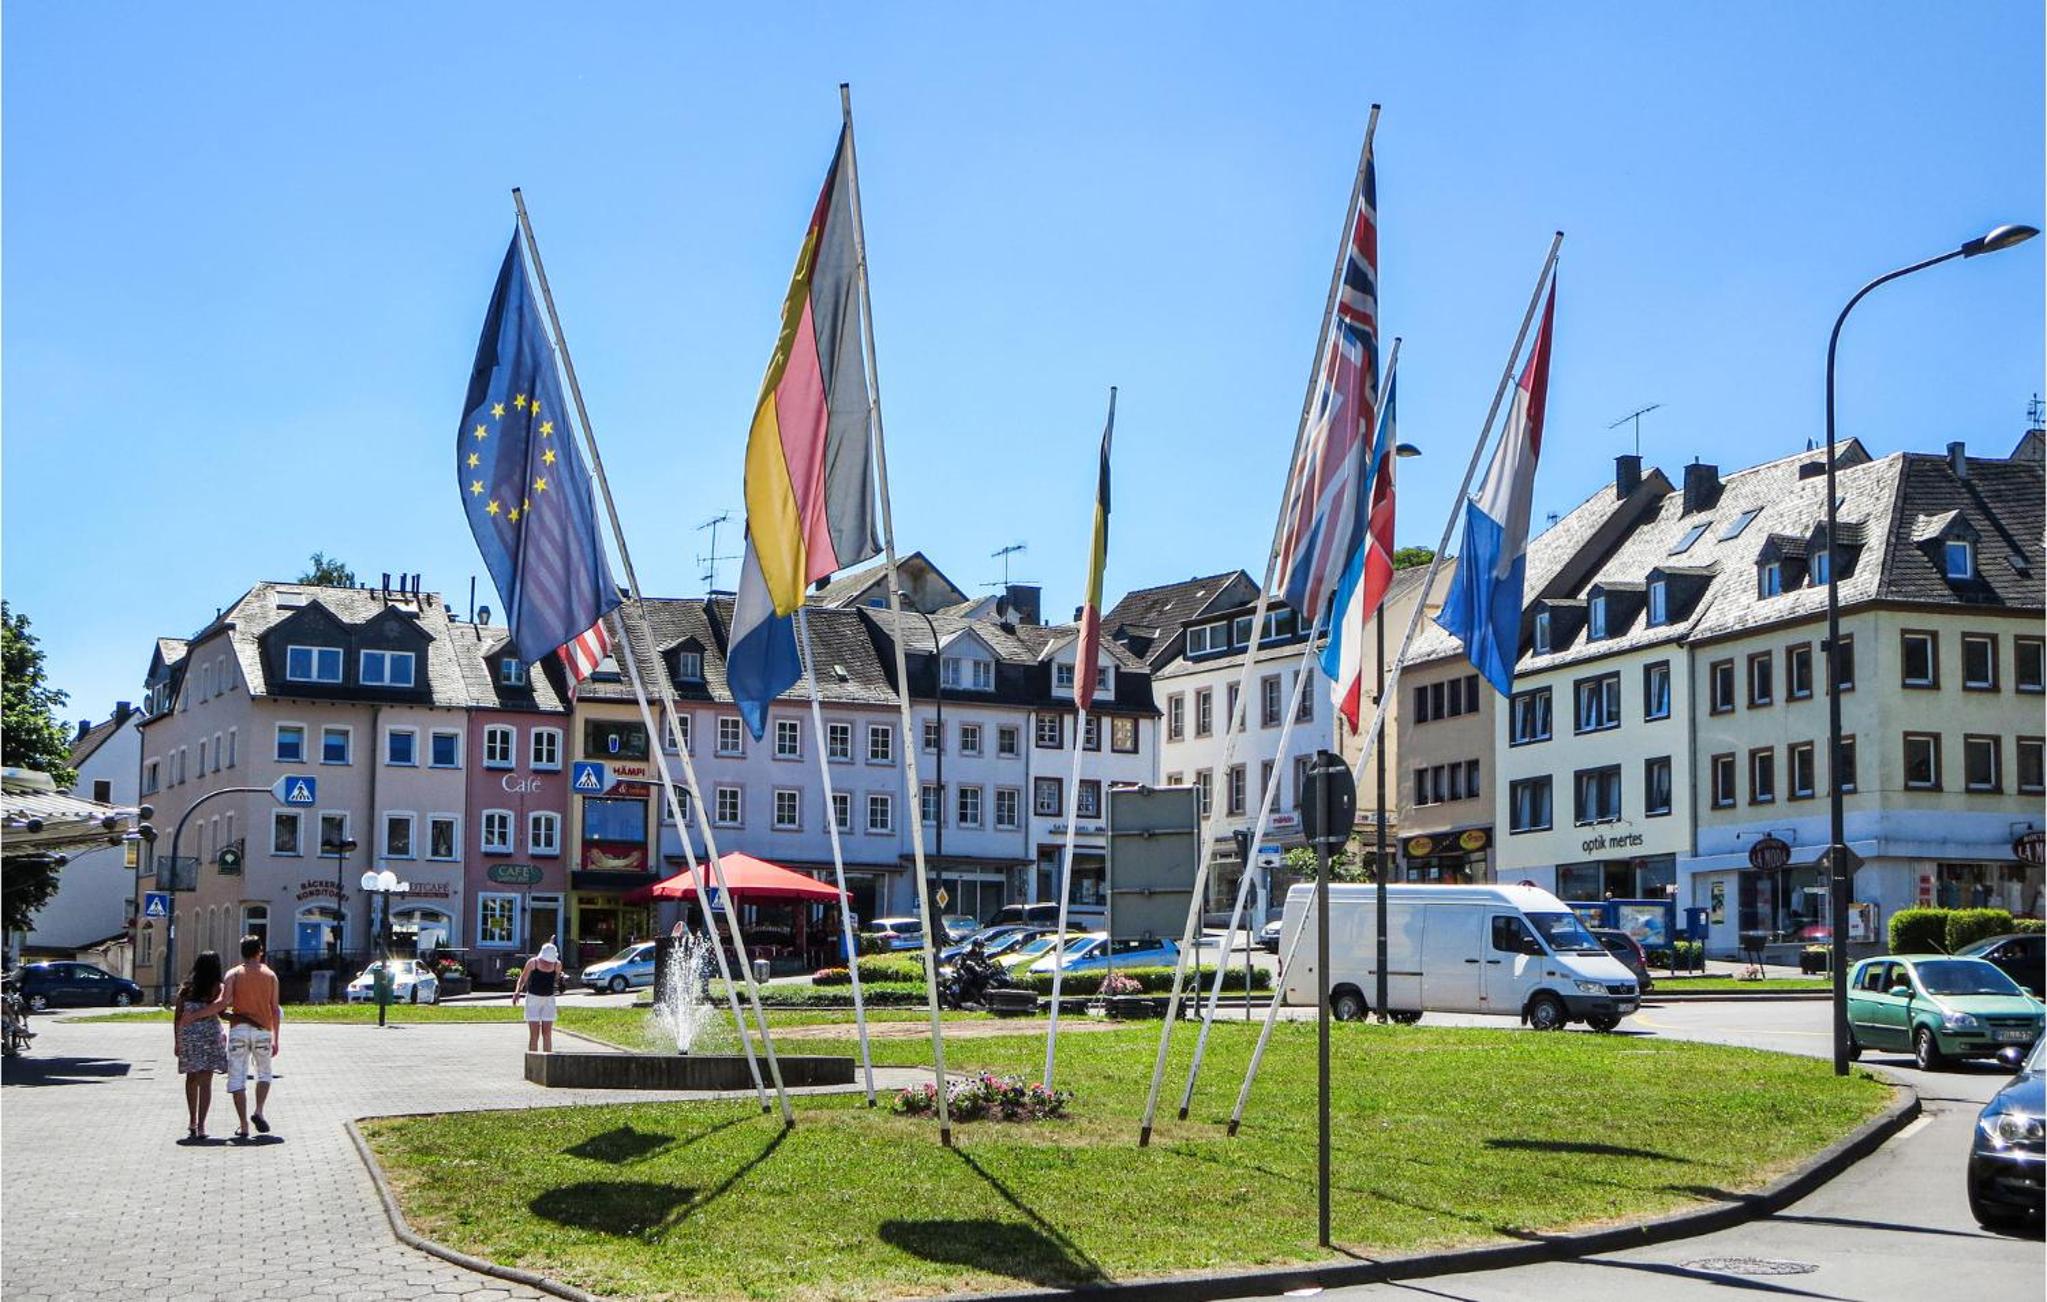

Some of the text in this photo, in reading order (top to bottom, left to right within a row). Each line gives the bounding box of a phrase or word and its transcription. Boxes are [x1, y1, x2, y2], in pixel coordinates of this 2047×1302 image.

[502, 773, 542, 793] Café
[1582, 833, 1643, 855] optik mertes
[2017, 843, 2032, 862] LA
